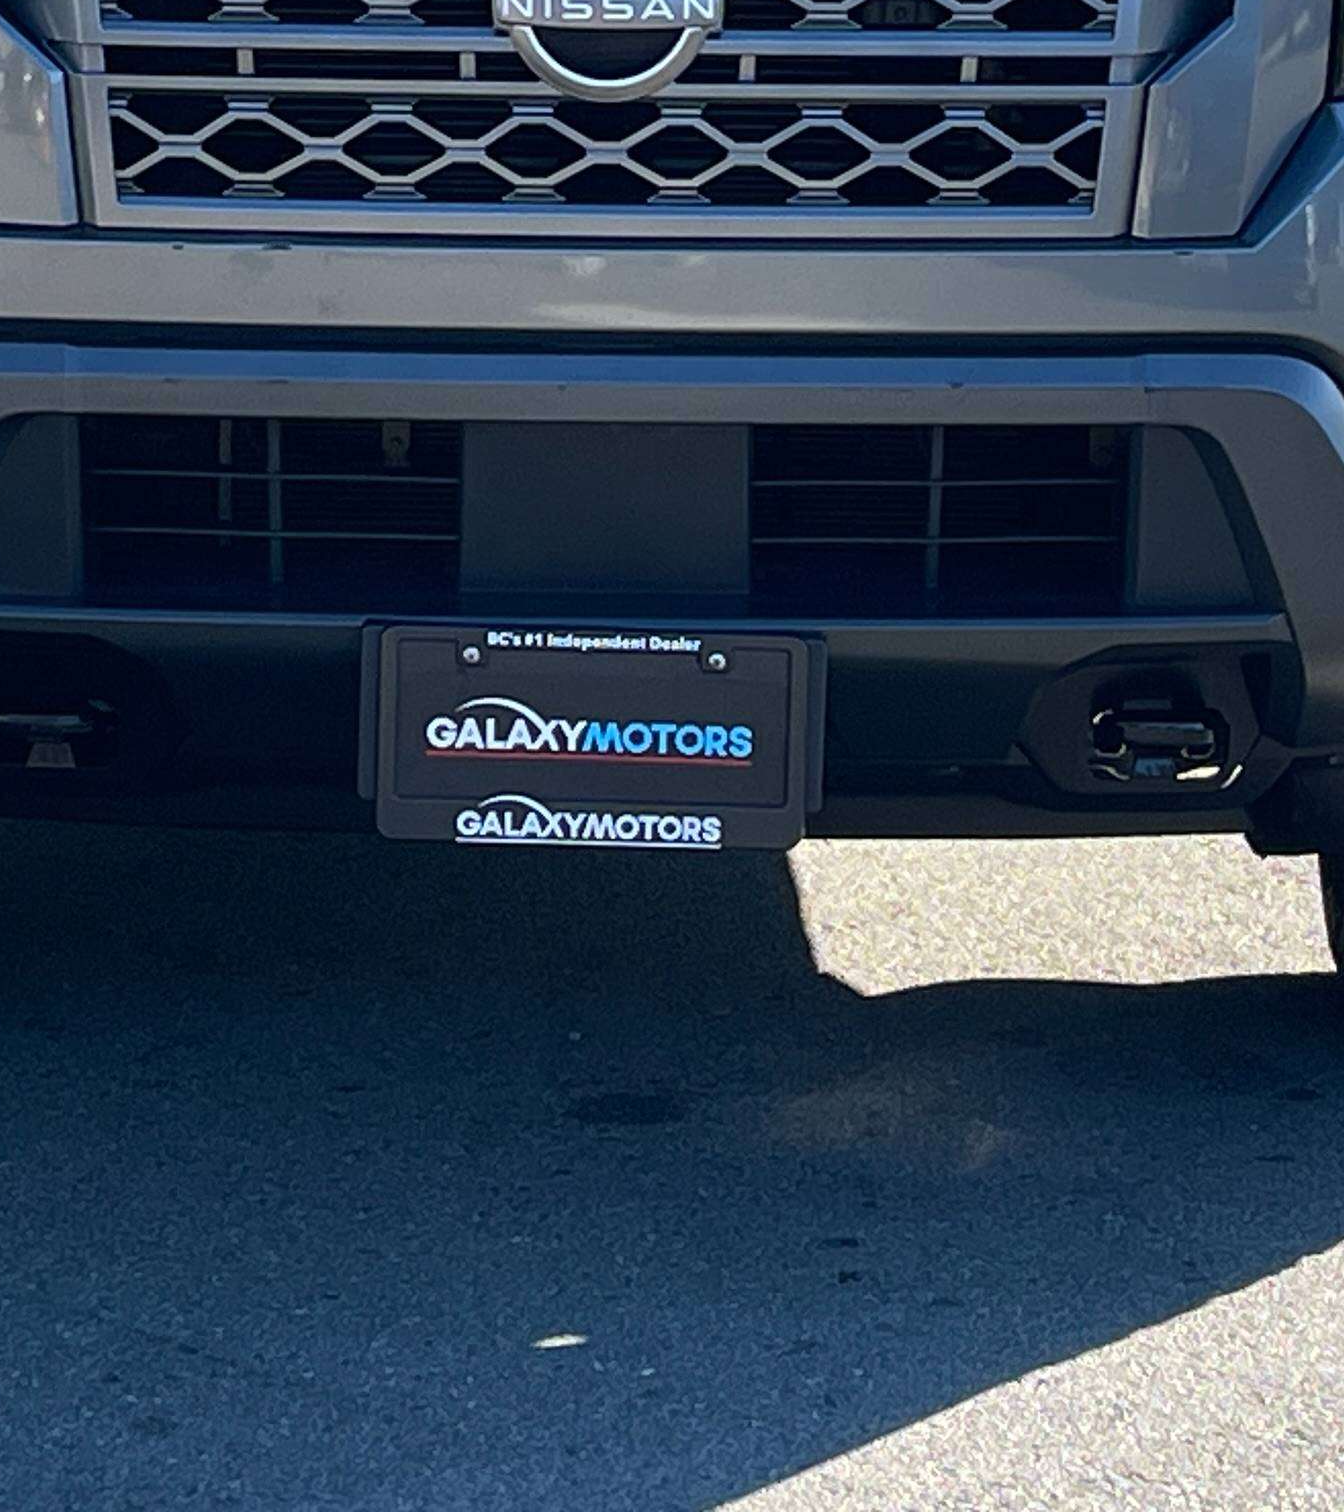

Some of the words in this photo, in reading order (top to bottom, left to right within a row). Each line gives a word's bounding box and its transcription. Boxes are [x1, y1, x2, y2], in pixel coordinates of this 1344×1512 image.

[487, 631, 521, 647] BC's
[524, 632, 543, 648] #1
[546, 633, 647, 652] Independent
[649, 635, 702, 652] Dealer
